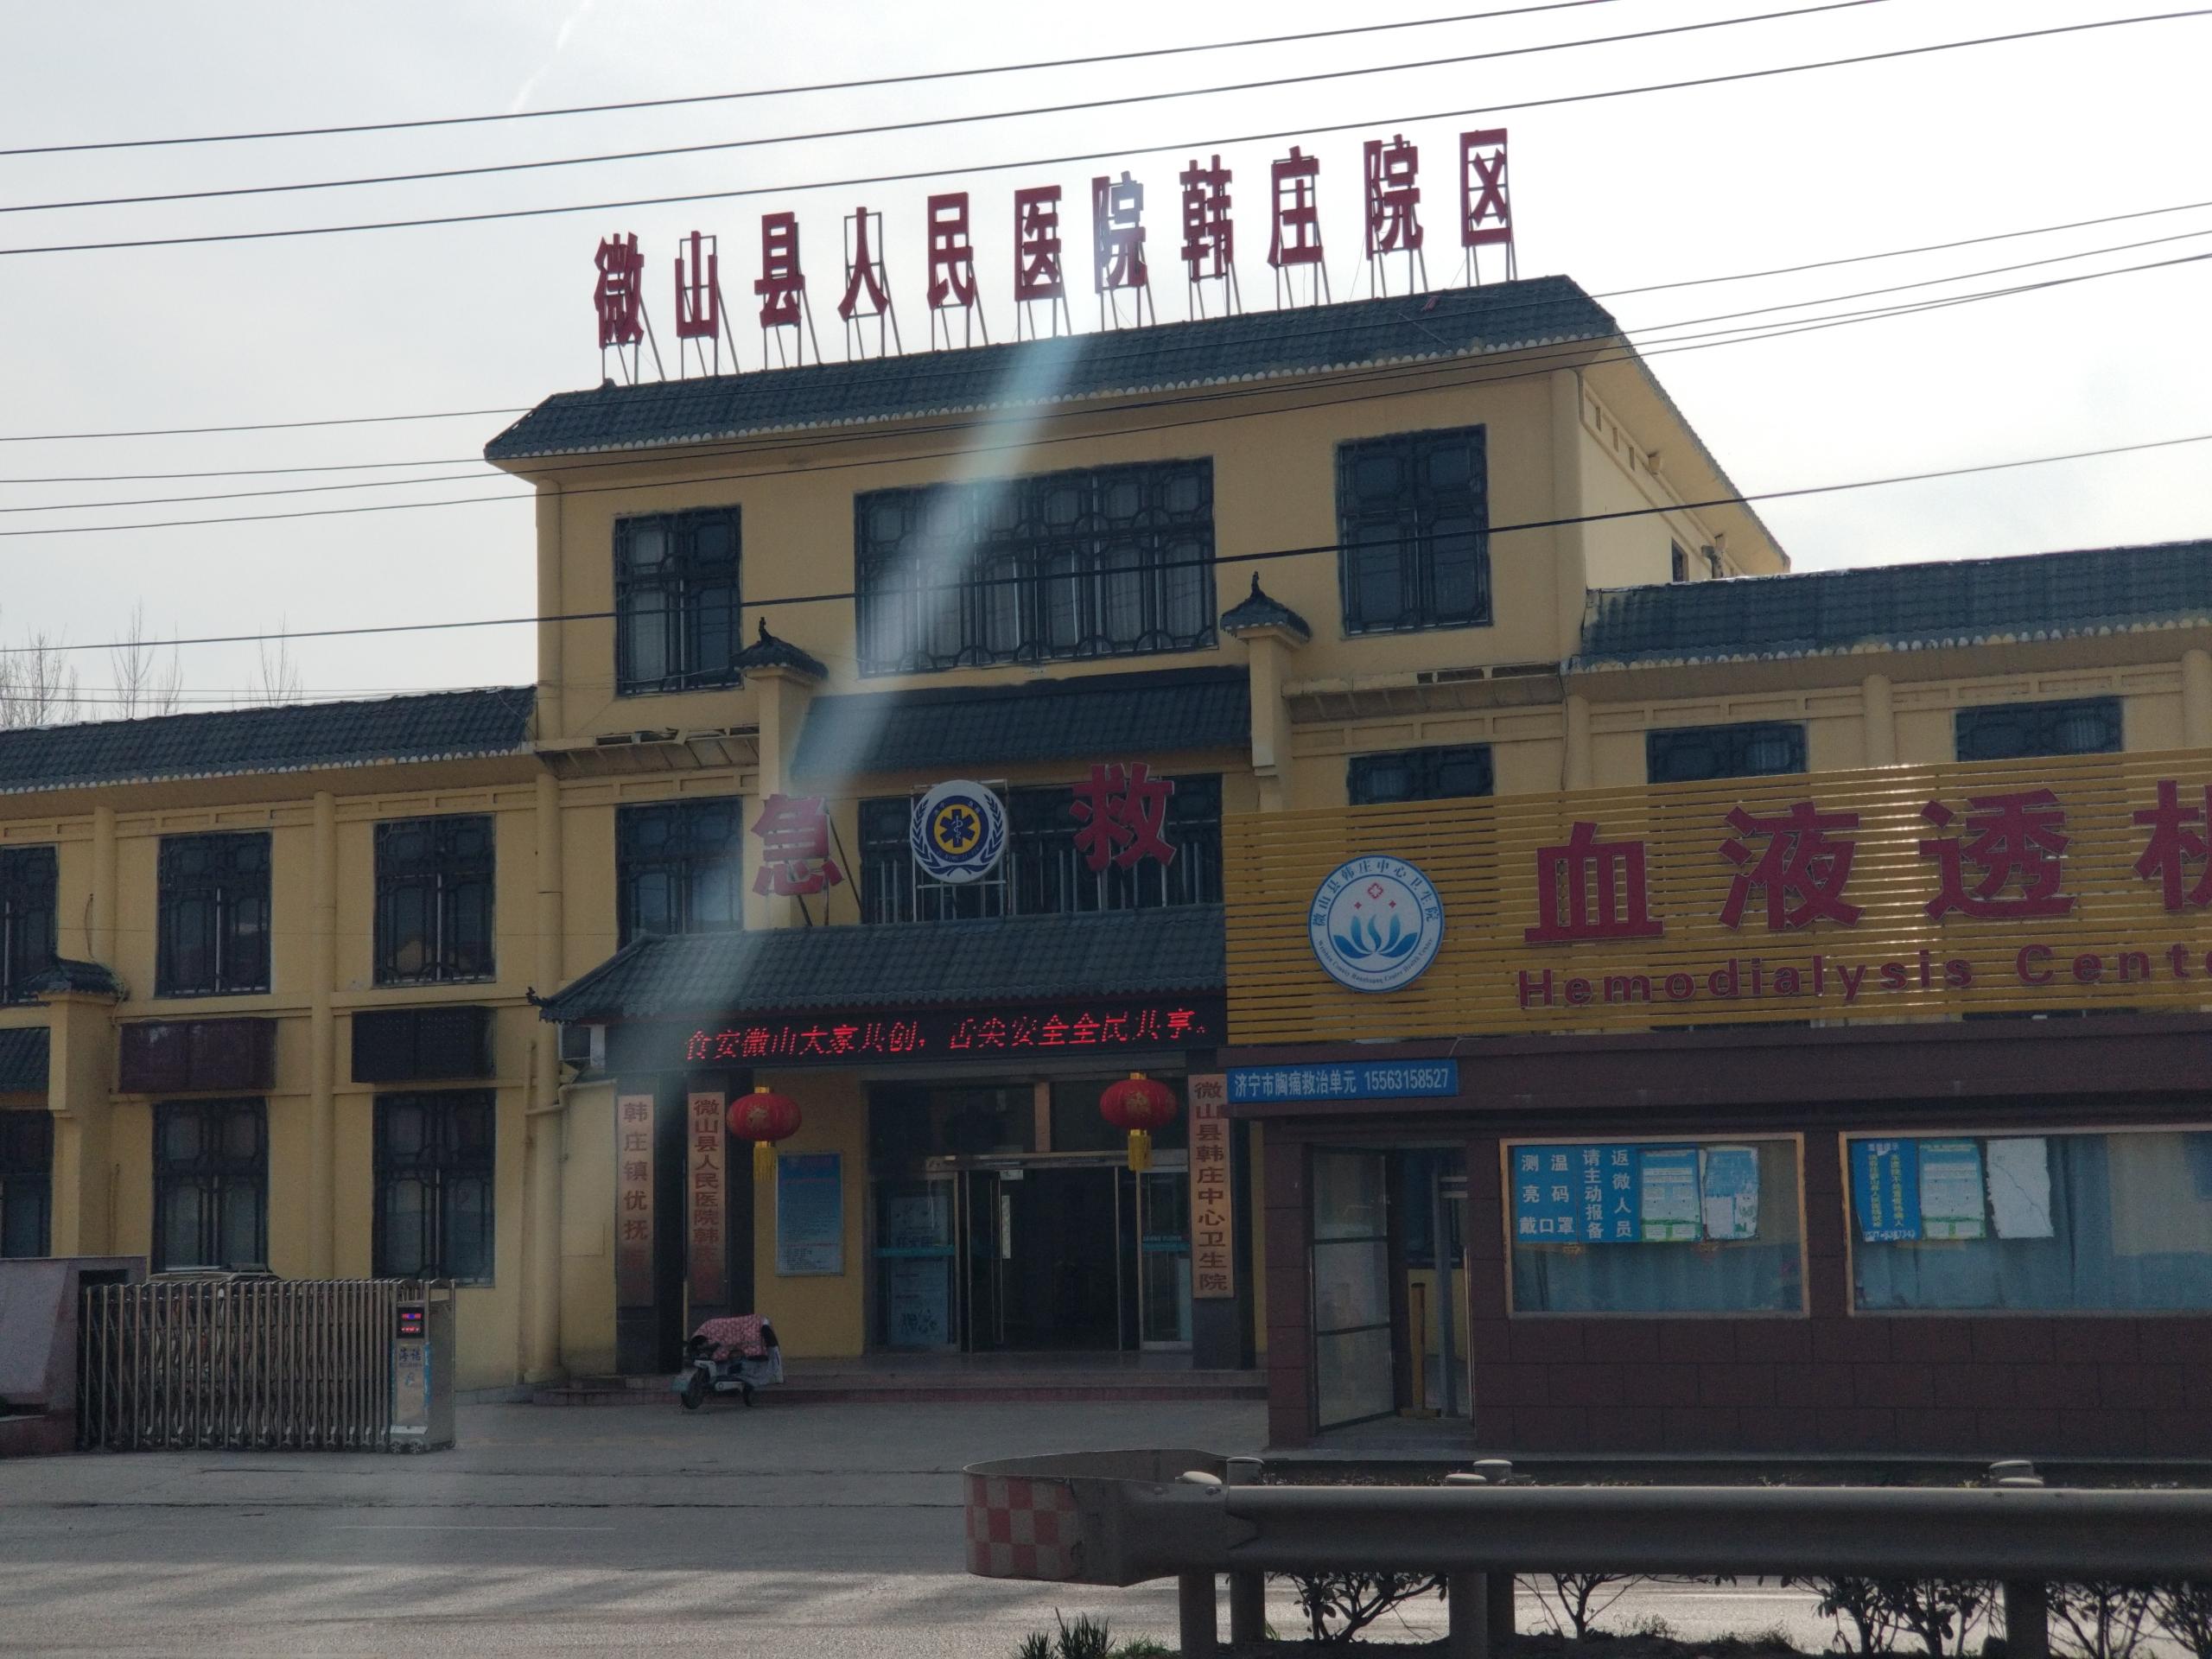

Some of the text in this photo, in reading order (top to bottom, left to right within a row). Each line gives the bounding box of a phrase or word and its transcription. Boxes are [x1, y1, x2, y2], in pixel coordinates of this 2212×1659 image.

[594, 127, 1512, 348] 微山县人民医院韩庄院区
[751, 762, 1177, 897] 急 救
[1517, 943, 2212, 1009] Hemodialysis Cent
[1234, 1067, 1449, 1097] 济宁市胸痛救治单元 15563158527
[1193, 1081, 1228, 1292] 微山县韩庄中心卫生院
[1522, 1154, 1569, 1173] 测温
[1522, 1184, 1570, 1204] 亮码
[1582, 1148, 1605, 1239] 请主动报备
[1611, 1149, 1633, 1238] 返微人员
[1519, 1217, 1575, 1236] 戴口罩
